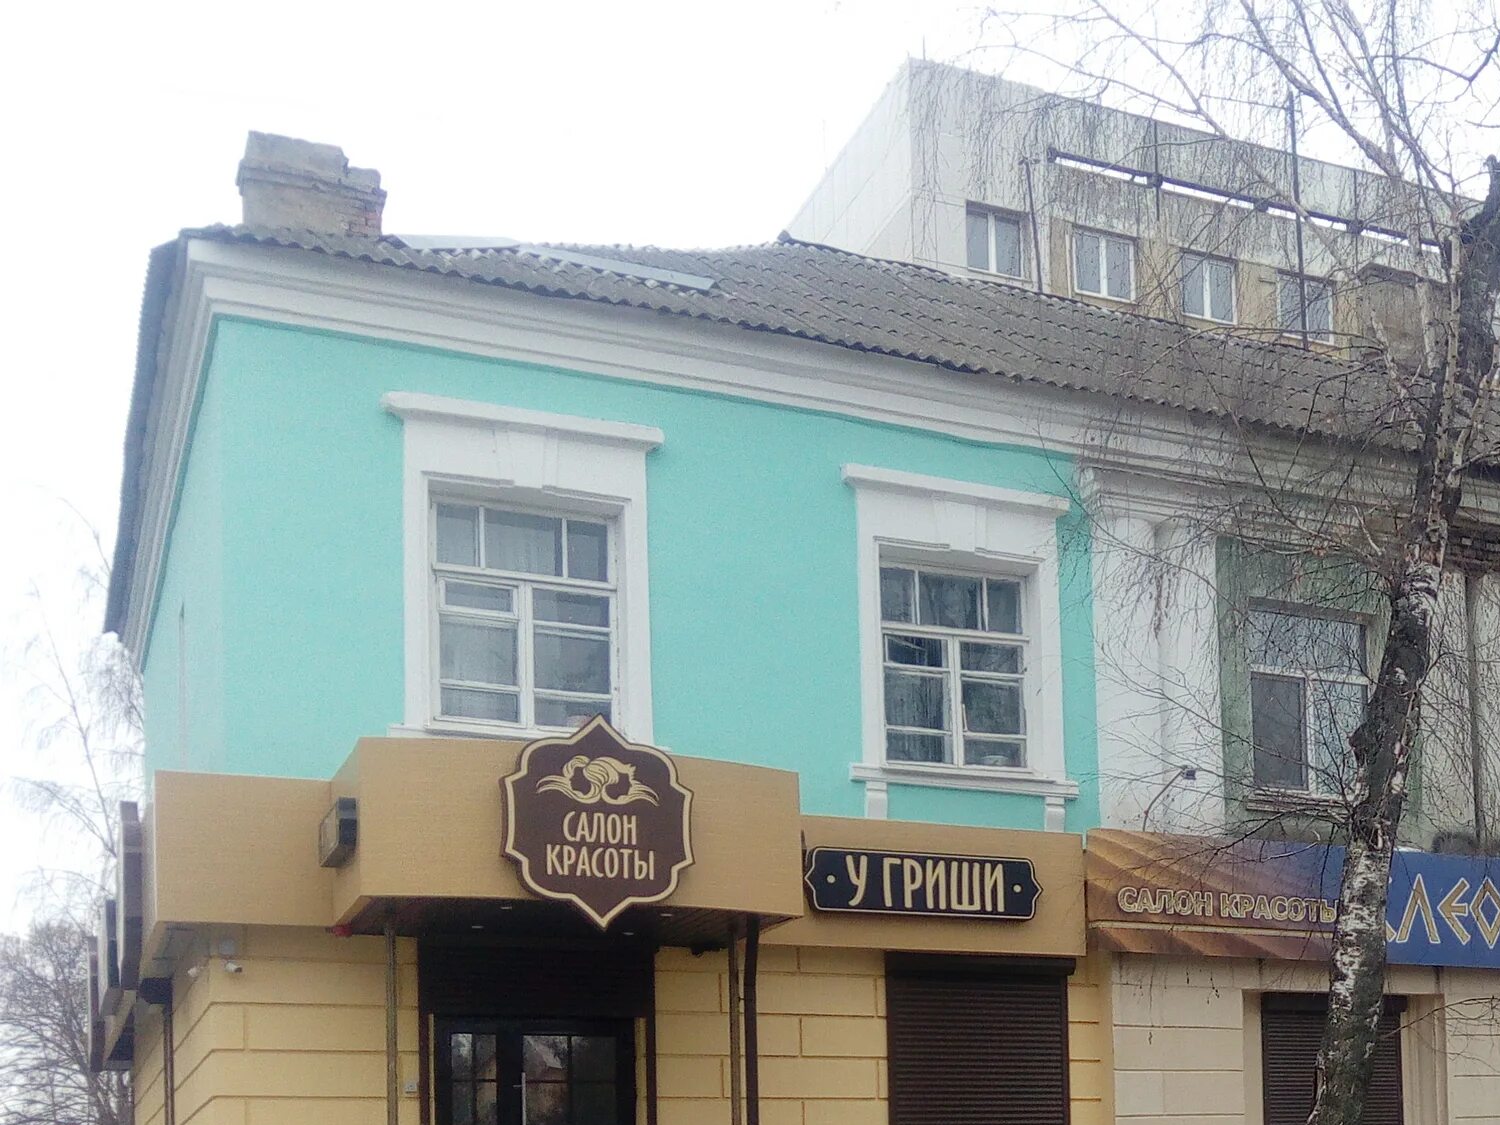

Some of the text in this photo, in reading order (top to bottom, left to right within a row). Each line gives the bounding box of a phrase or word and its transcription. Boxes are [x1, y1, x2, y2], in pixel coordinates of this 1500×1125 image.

[563, 810, 637, 846] САЛОН
[546, 843, 655, 880] КРАСОТЫ
[845, 854, 1005, 913] У ГРИШИ
[1117, 886, 1213, 917] САЛОН
